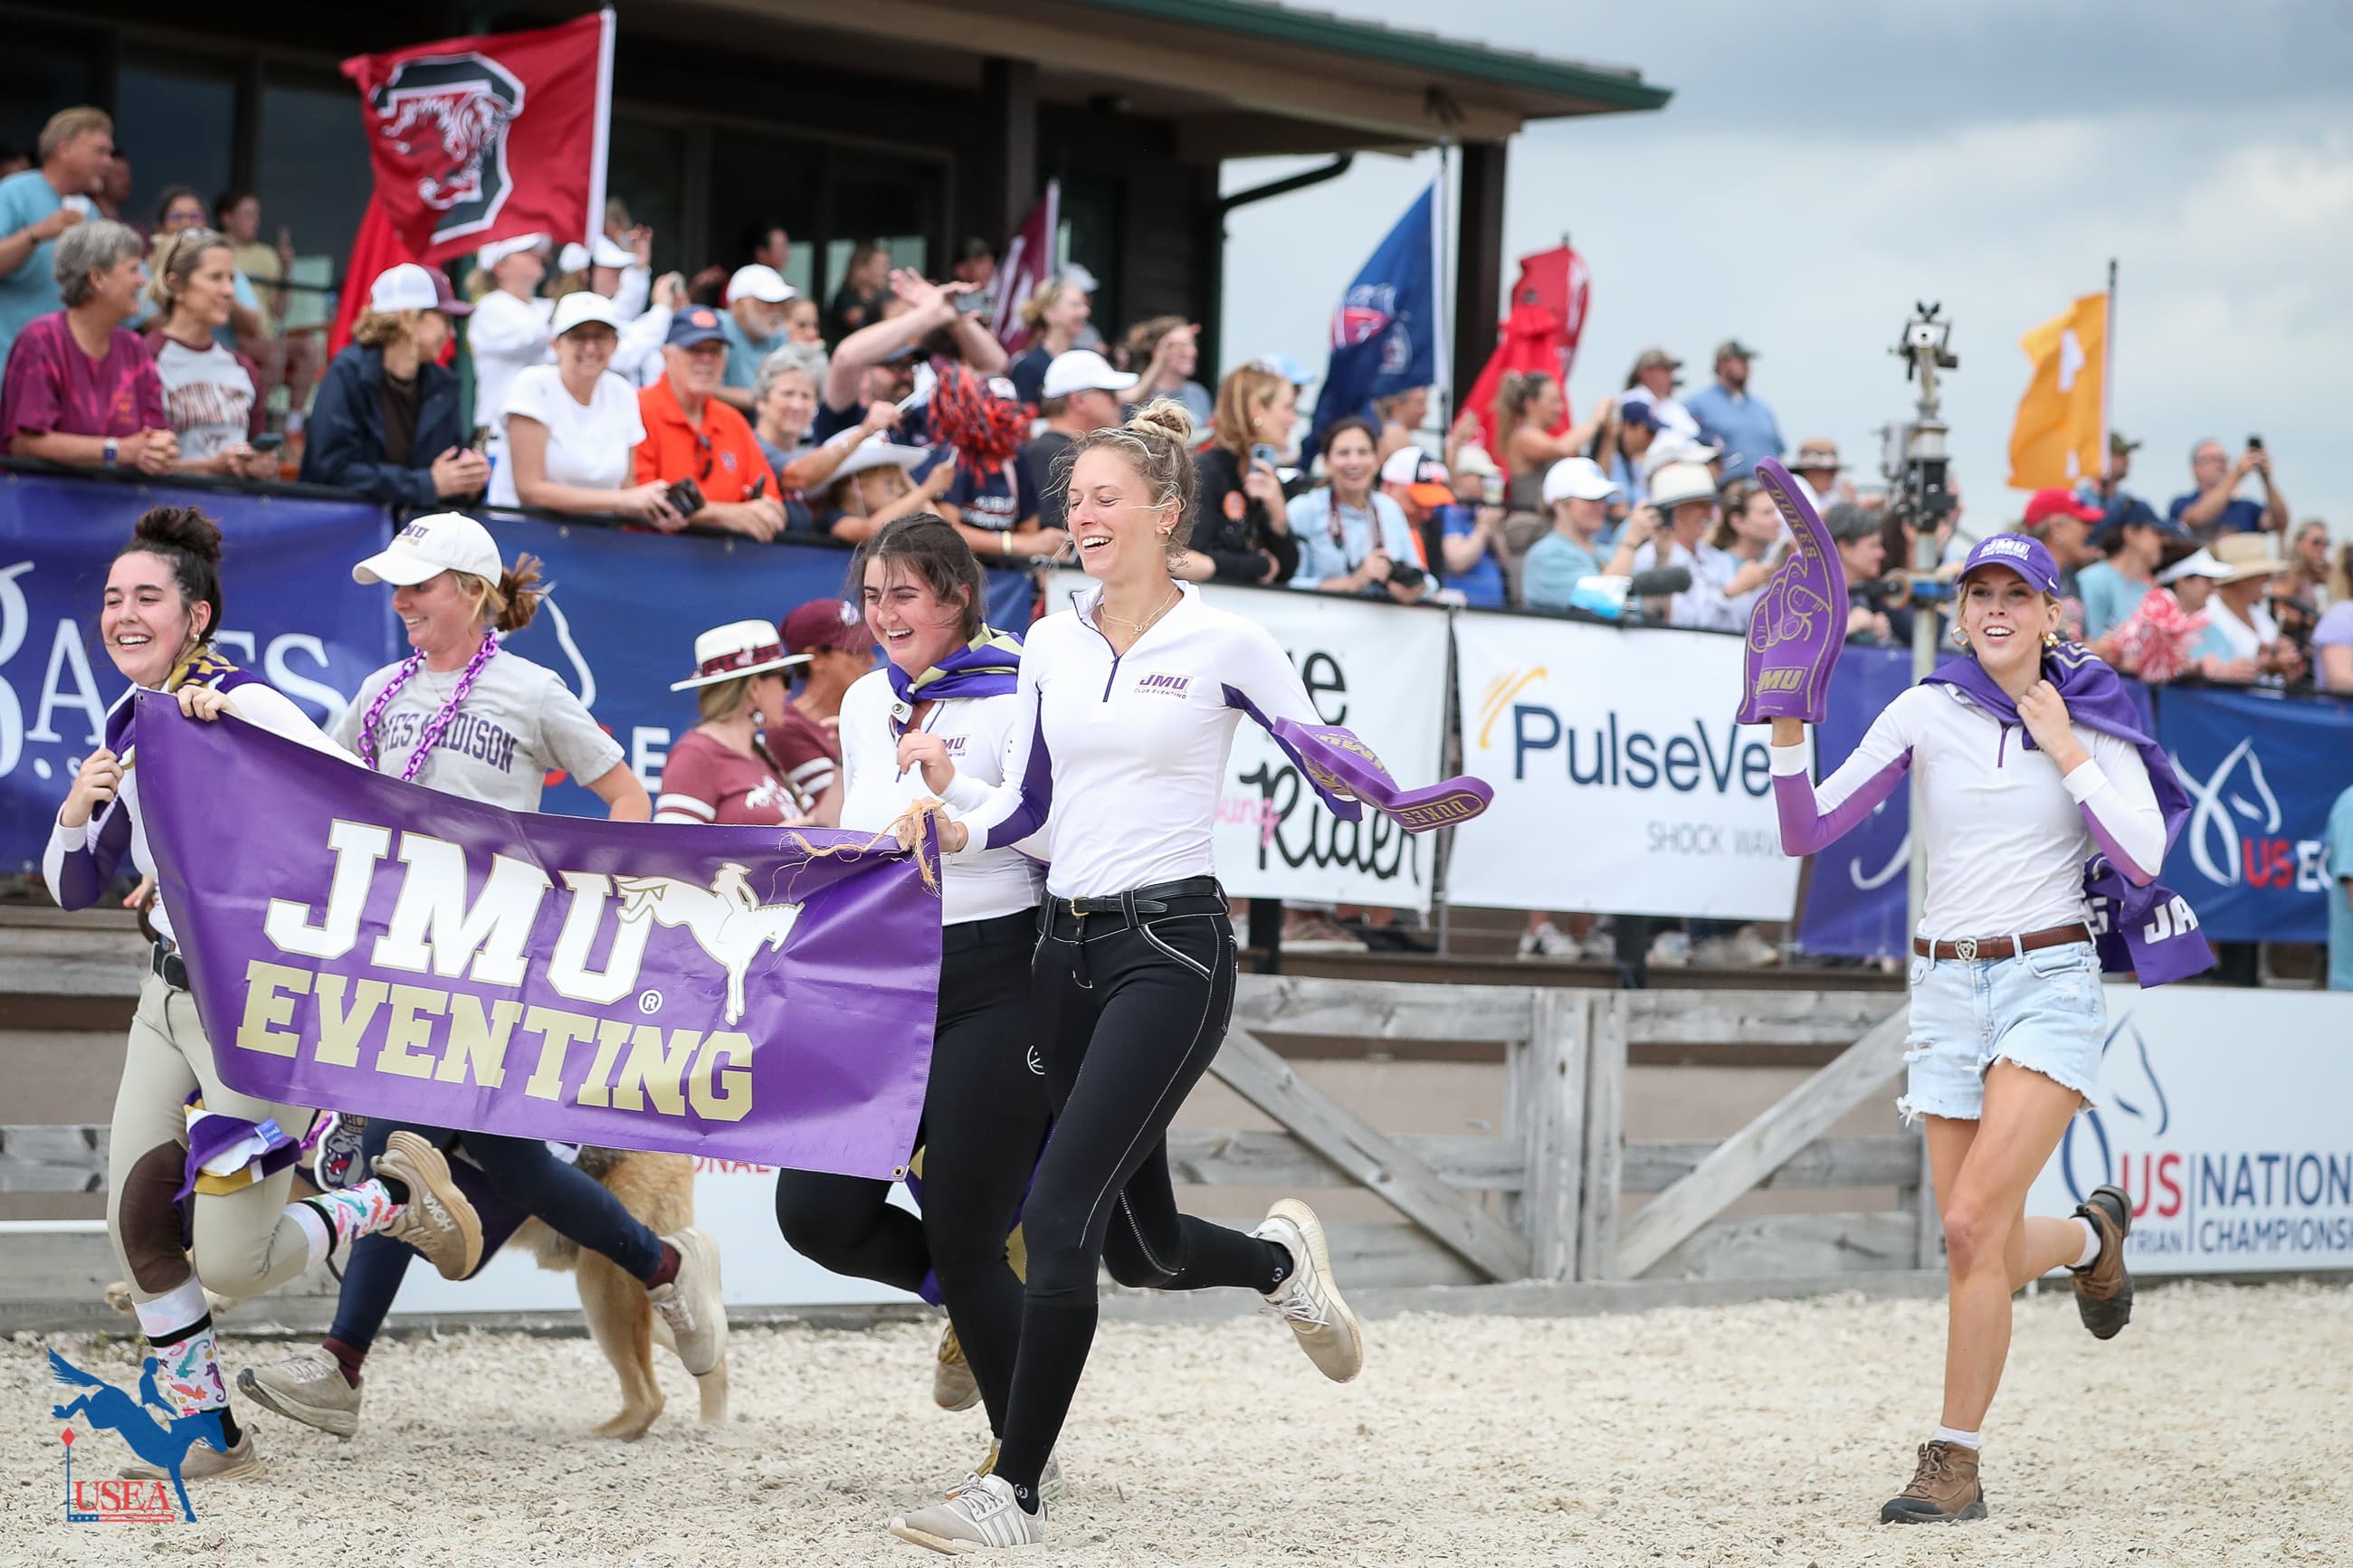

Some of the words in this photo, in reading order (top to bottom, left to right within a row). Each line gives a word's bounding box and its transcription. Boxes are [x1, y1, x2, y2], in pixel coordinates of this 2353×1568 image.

[1770, 489, 1817, 559] DUKES
[1980, 537, 2031, 554] JMU
[1139, 674, 1190, 690] JMU
[941, 736, 966, 750] MU
[1215, 795, 1281, 849] ung
[1404, 798, 1471, 825] DUKES
[1647, 819, 1725, 857] SHOCK
[263, 818, 653, 1005] JMU
[235, 959, 754, 1123] EVENTING
[2120, 1152, 2182, 1218] US
[422, 1189, 458, 1233] HOKA
